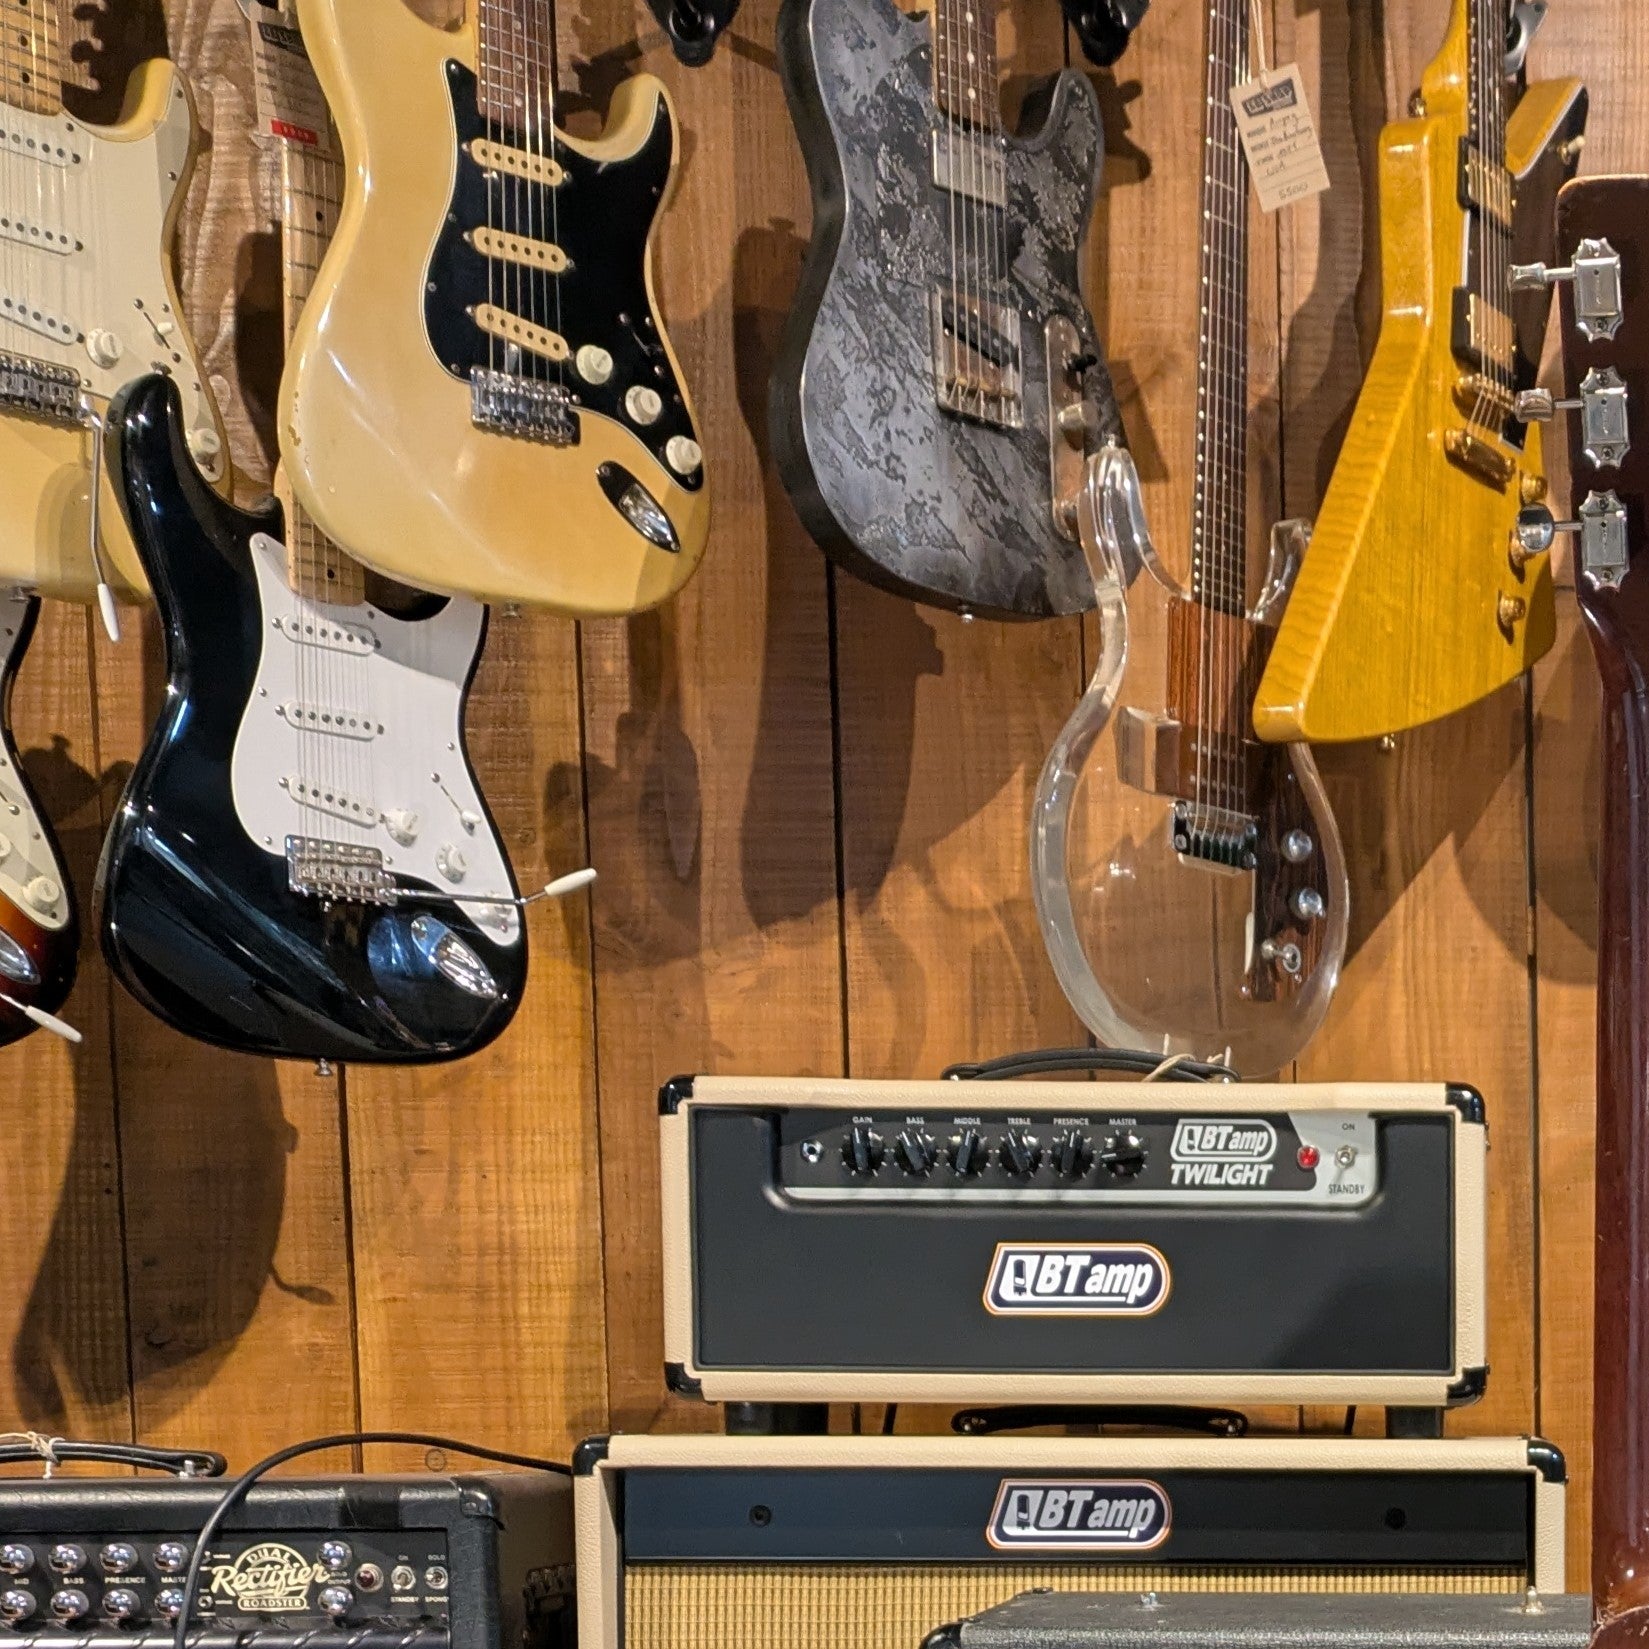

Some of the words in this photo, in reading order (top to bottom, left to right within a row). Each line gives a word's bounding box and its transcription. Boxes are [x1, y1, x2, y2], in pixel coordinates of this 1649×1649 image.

[852, 1116, 873, 1124] GAIN
[906, 1116, 925, 1125] BASS
[953, 1117, 981, 1125] MIDDLE
[1007, 1117, 1032, 1126] TREBLE
[1053, 1117, 1090, 1126] PRESENCE
[1108, 1118, 1137, 1126] MASTER
[1342, 1122, 1355, 1131] ON
[1170, 1164, 1273, 1185] TWILIGHT
[1328, 1184, 1366, 1194] STANDBY
[246, 1548, 293, 1565] DUAL
[63, 1577, 85, 1585] BASS
[210, 1563, 331, 1598] Rectifier
[243, 1599, 301, 1607] ROADSTER
